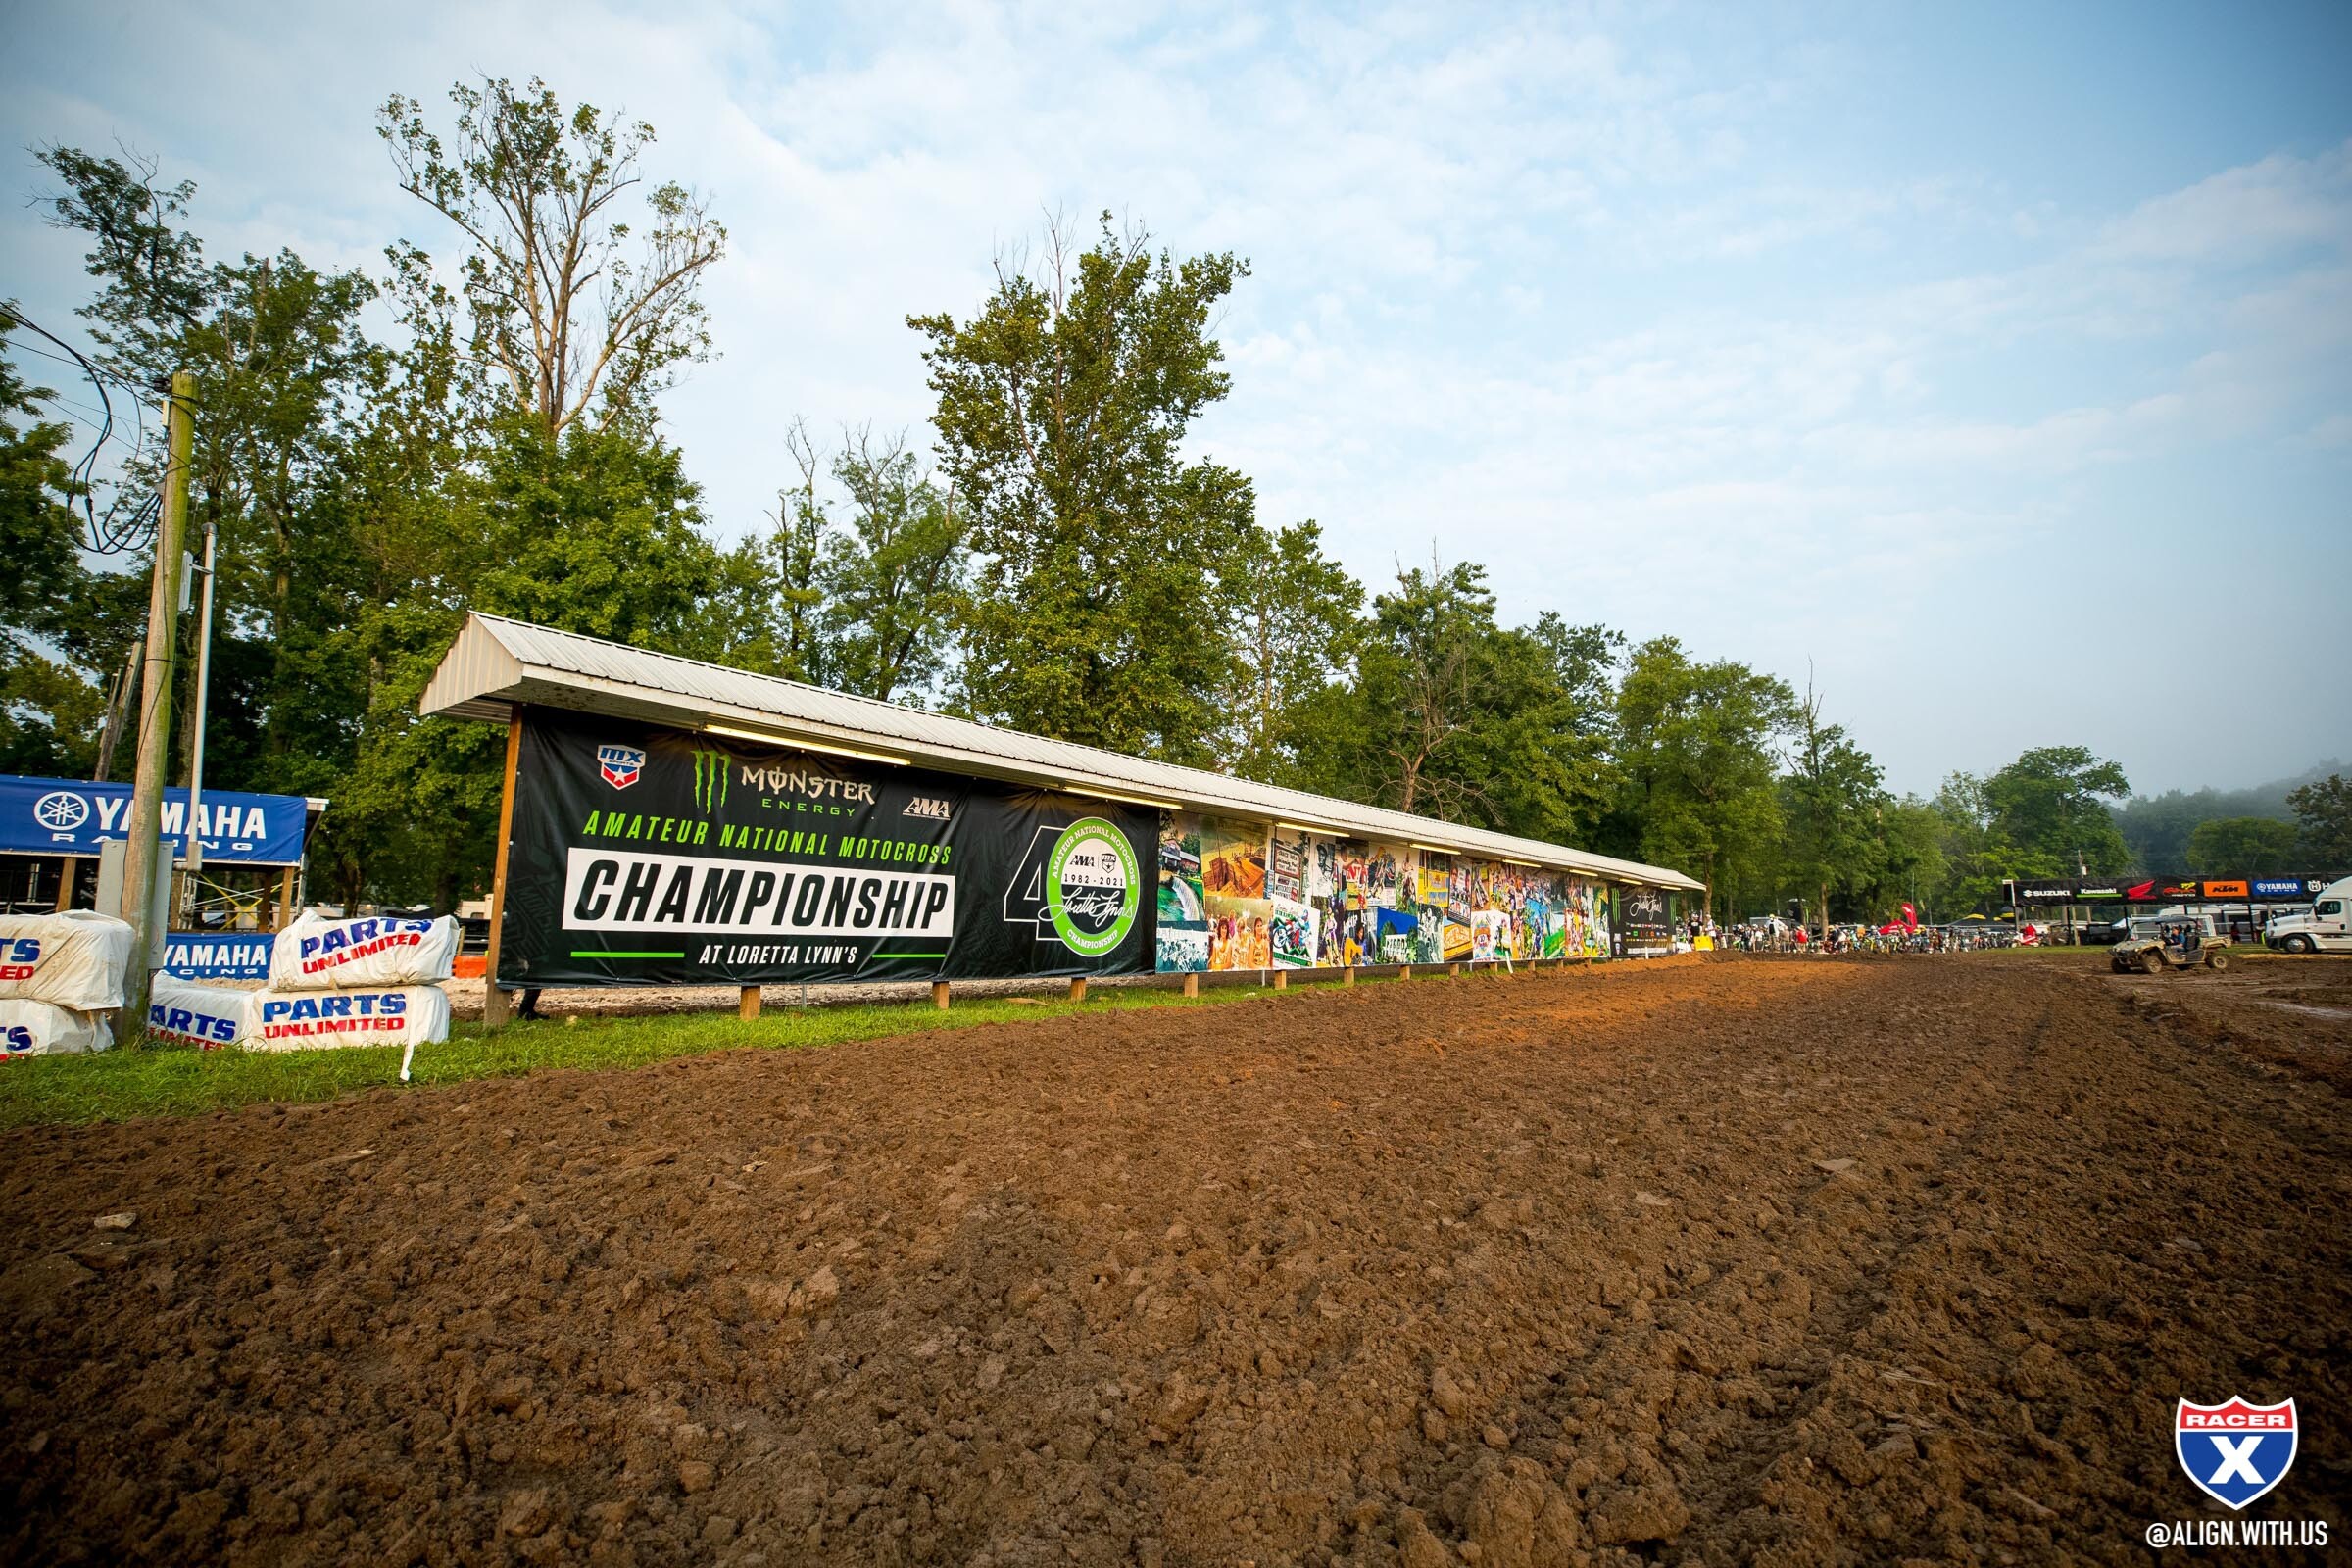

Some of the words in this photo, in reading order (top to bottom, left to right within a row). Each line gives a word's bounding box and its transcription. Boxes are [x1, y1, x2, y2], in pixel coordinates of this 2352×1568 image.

[761, 798, 856, 817] ENERGY
[904, 797, 950, 817] AMA
[582, 810, 709, 845] AMATEUR
[719, 824, 828, 856] NATIONAL
[838, 836, 952, 865] MOTOCROSS
[1052, 835, 1075, 879] AMATEUR
[1074, 825, 1109, 839] NATIONAL
[1109, 832, 1136, 885] MOTOCROSS
[574, 859, 949, 929] CHAMPIONSHIP
[1064, 874, 1090, 884] 1982
[1099, 876, 1124, 887] 2021
[300, 918, 433, 959] PARTS
[303, 933, 421, 974] UNLIMITED
[1066, 929, 1118, 949] CHAMPIONSHIP
[699, 945, 723, 964] AT
[727, 945, 799, 964] LORETTA
[804, 946, 858, 964] LYNN'S
[150, 1004, 236, 1042] ARTS
[263, 993, 407, 1023] PARTS
[264, 1017, 405, 1039] UNLIMITED
